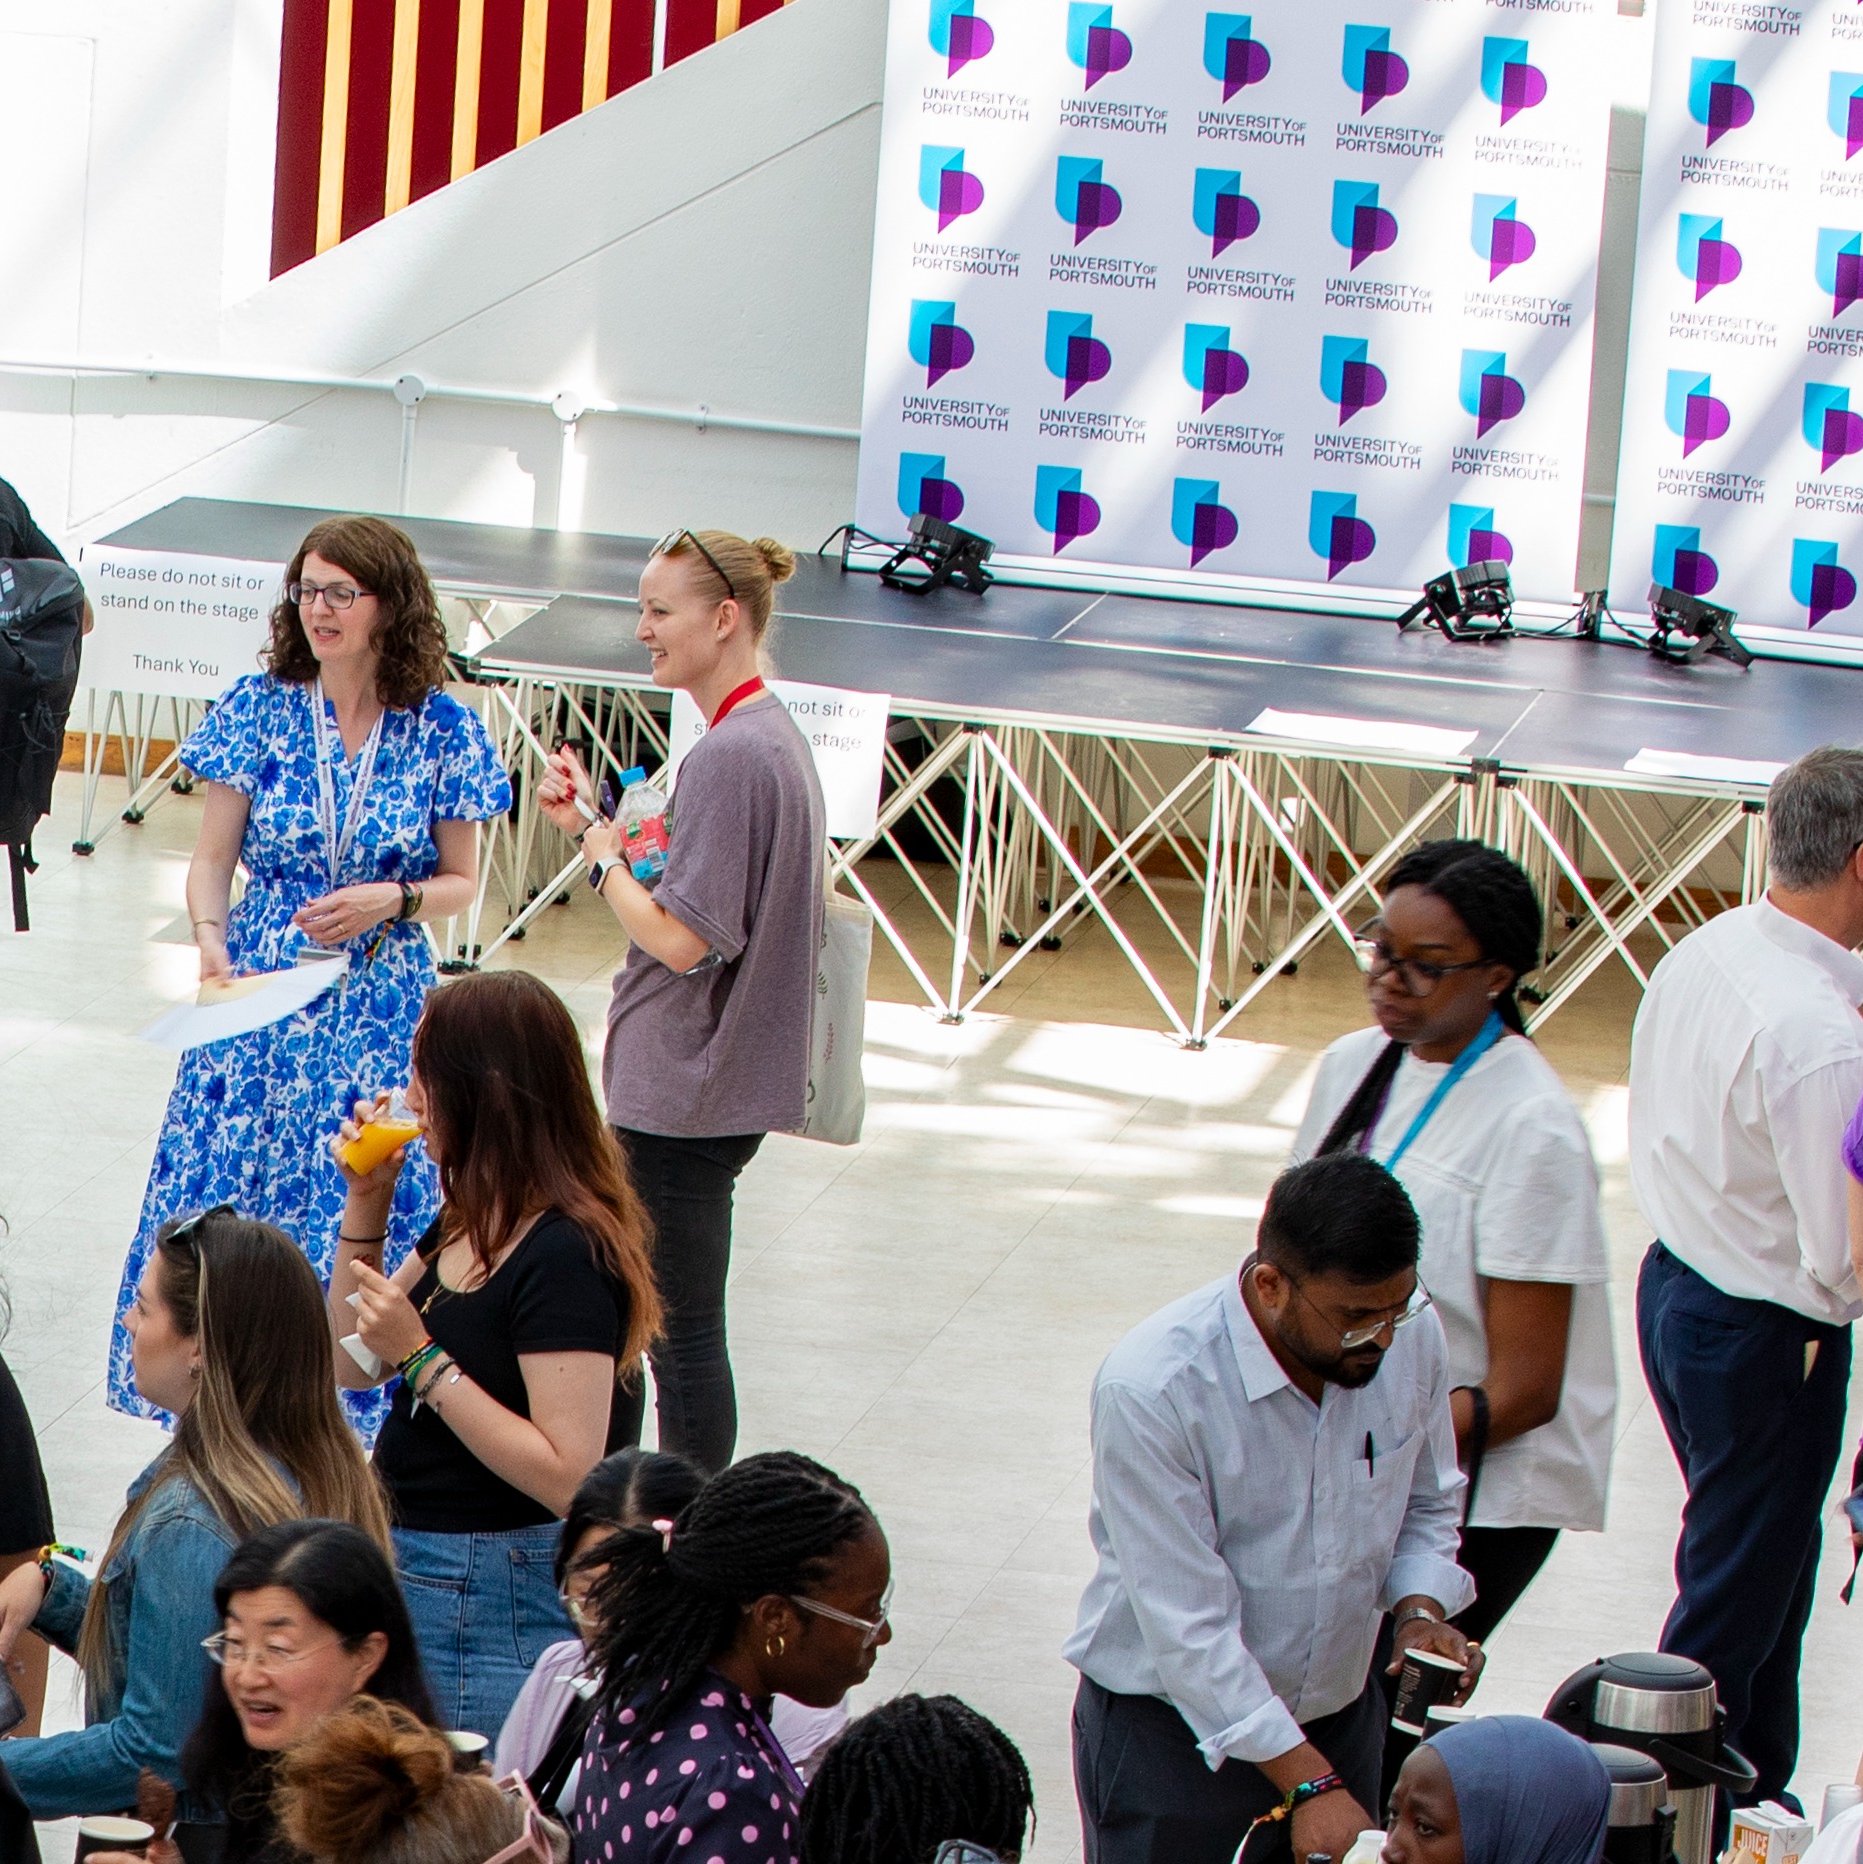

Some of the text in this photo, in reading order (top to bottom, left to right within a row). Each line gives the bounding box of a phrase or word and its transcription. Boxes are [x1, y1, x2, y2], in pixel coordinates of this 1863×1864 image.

[1197, 125, 1305, 147] PORTSMOUTH
[1048, 269, 1156, 290] PORTSMOUTH
[901, 410, 1009, 432] PORTSMOUTH
[99, 562, 265, 591] Please do not sit or
[100, 593, 259, 623] stand on the stage
[132, 653, 219, 677] Thank You
[784, 700, 843, 719] not sit
[1738, 1828, 1768, 1856] JUICE
